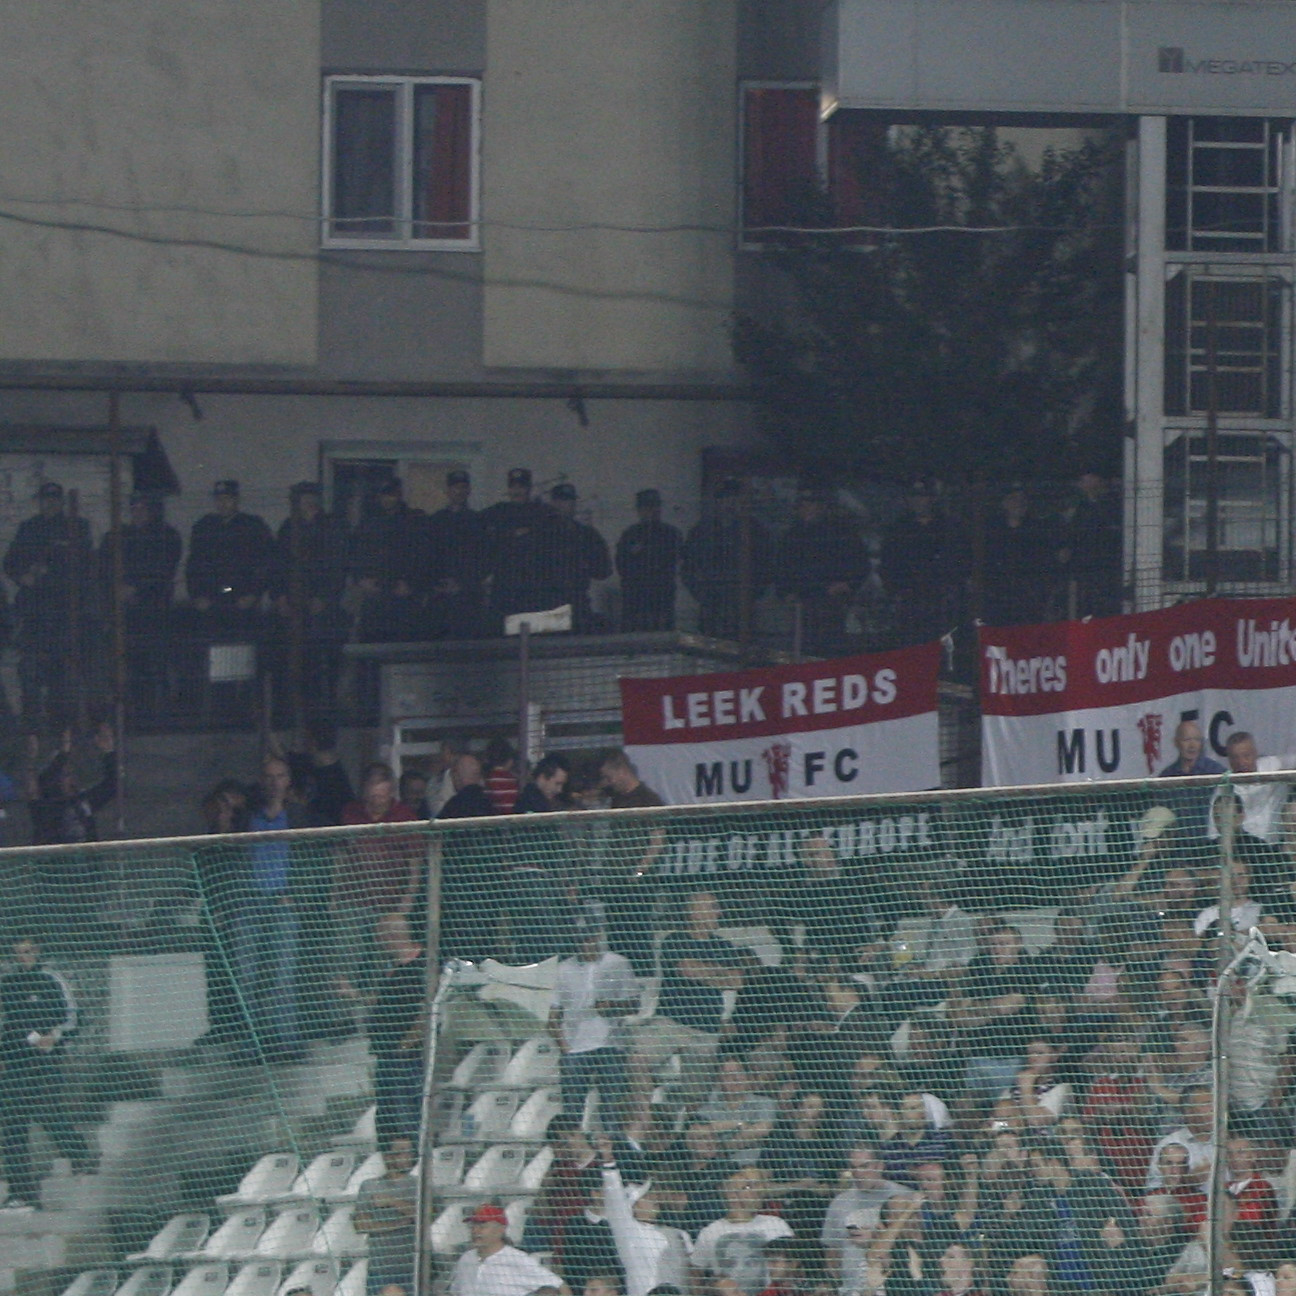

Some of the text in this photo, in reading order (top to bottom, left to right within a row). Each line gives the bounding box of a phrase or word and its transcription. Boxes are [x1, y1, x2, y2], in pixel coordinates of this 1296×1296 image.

[985, 645, 1067, 695] Theres
[1095, 636, 1150, 683] only
[1169, 632, 1216, 671] one
[662, 669, 898, 730] LEEK REDS
